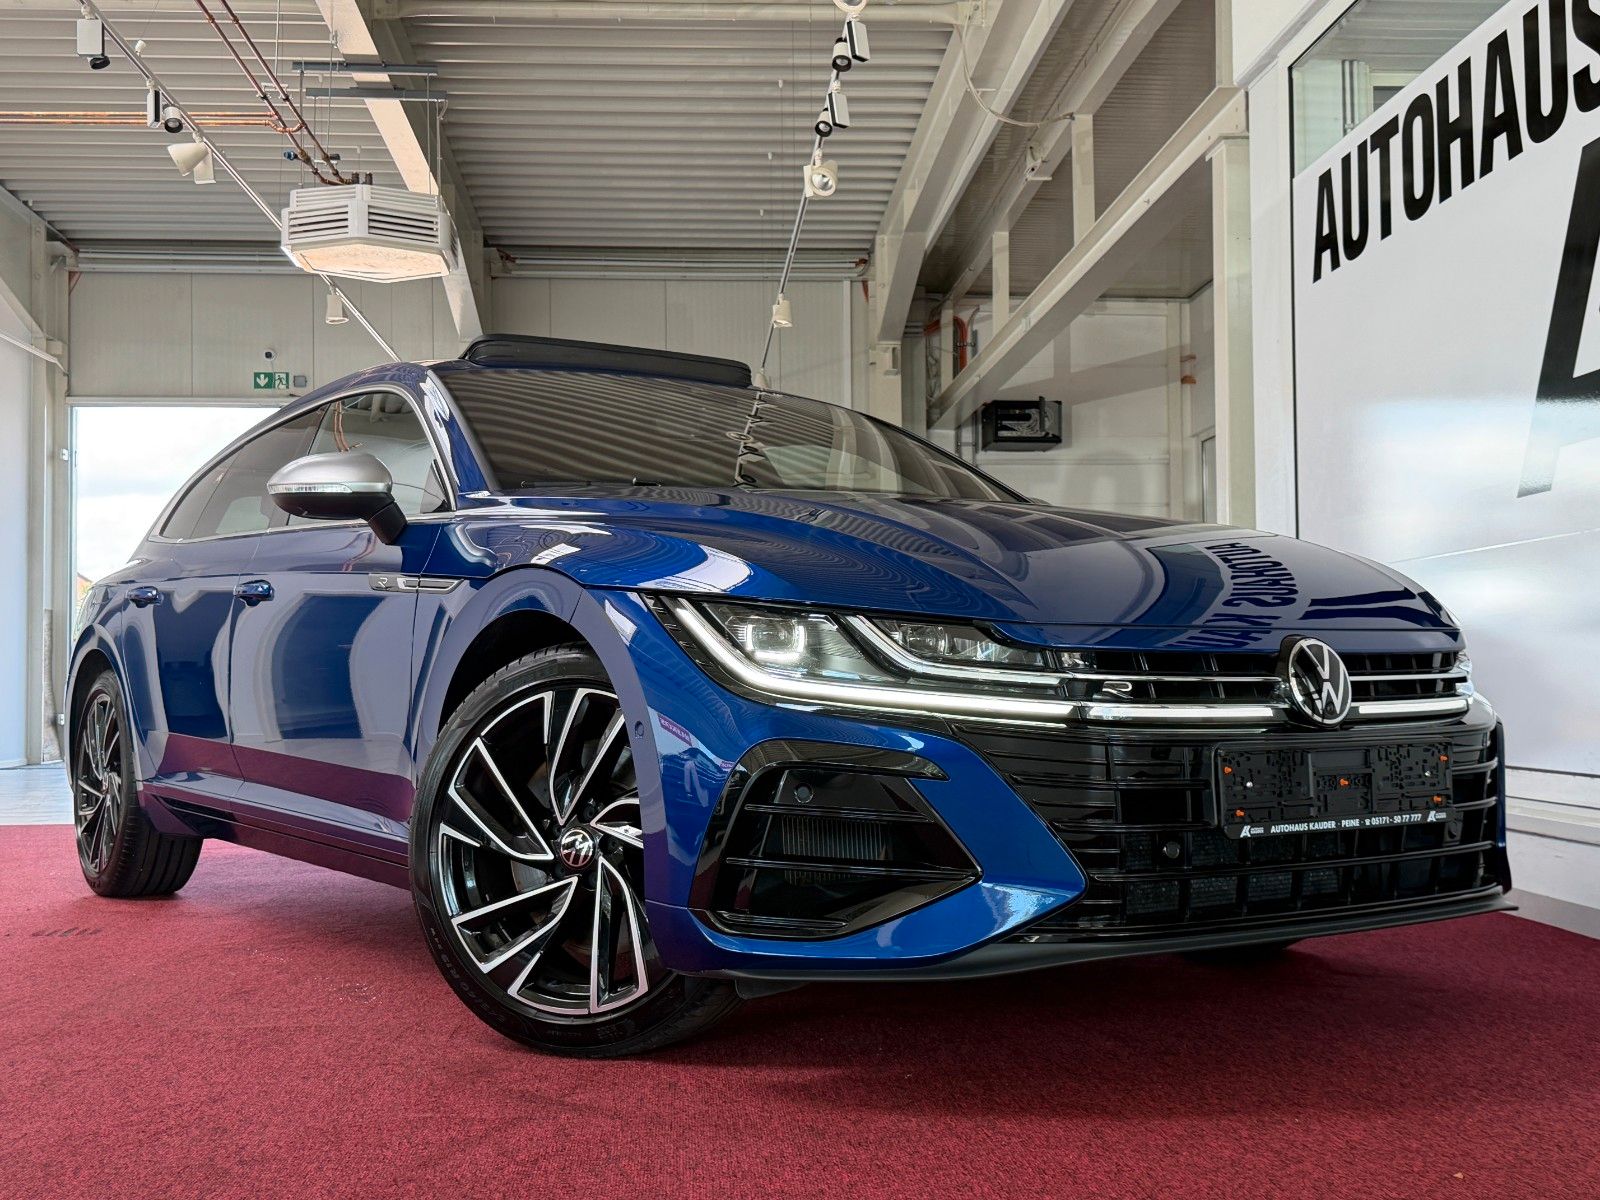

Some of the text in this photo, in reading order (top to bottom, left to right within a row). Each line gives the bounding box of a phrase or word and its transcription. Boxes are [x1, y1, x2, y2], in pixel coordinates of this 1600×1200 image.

[1270, 823, 1308, 834] AUTOHAUS
[1309, 821, 1336, 831] KAUDER
[1341, 819, 1360, 828] PEINE
